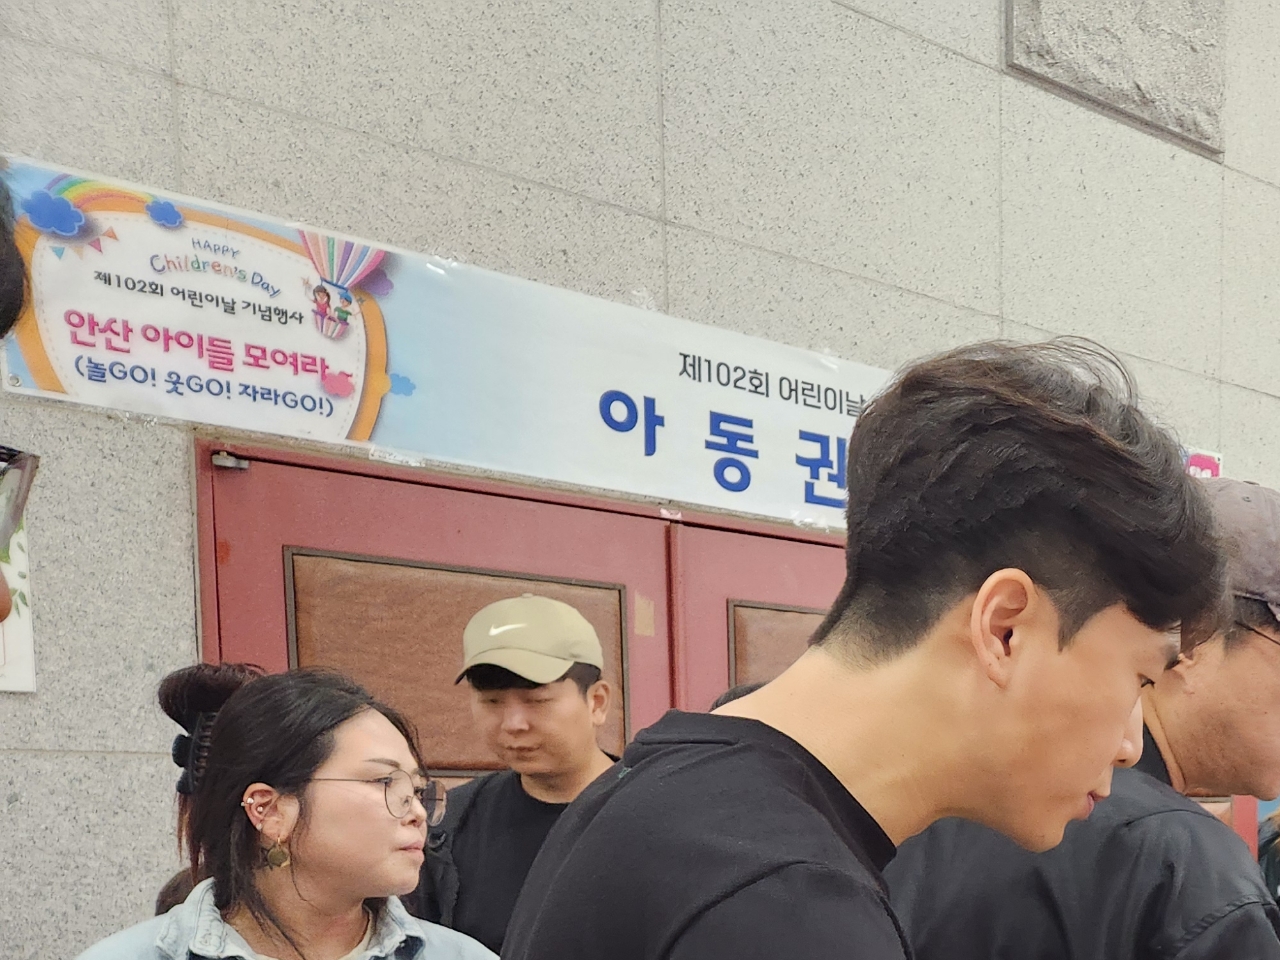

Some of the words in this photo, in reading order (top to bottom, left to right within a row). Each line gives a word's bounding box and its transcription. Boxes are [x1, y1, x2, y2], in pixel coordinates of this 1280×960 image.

[191, 237, 240, 259] HAPPY
[93, 270, 165, 297] 제102회
[170, 286, 237, 315] 어린이날
[241, 300, 304, 326] 기념행사
[150, 254, 248, 282] Children's
[250, 271, 281, 298] Day
[64, 308, 133, 354] 안산
[140, 324, 235, 373] 아이들
[74, 354, 156, 387] (놀GO!
[164, 371, 231, 400] 웃GO!
[238, 382, 334, 418] 자라GO!)
[679, 351, 770, 398] 제102회
